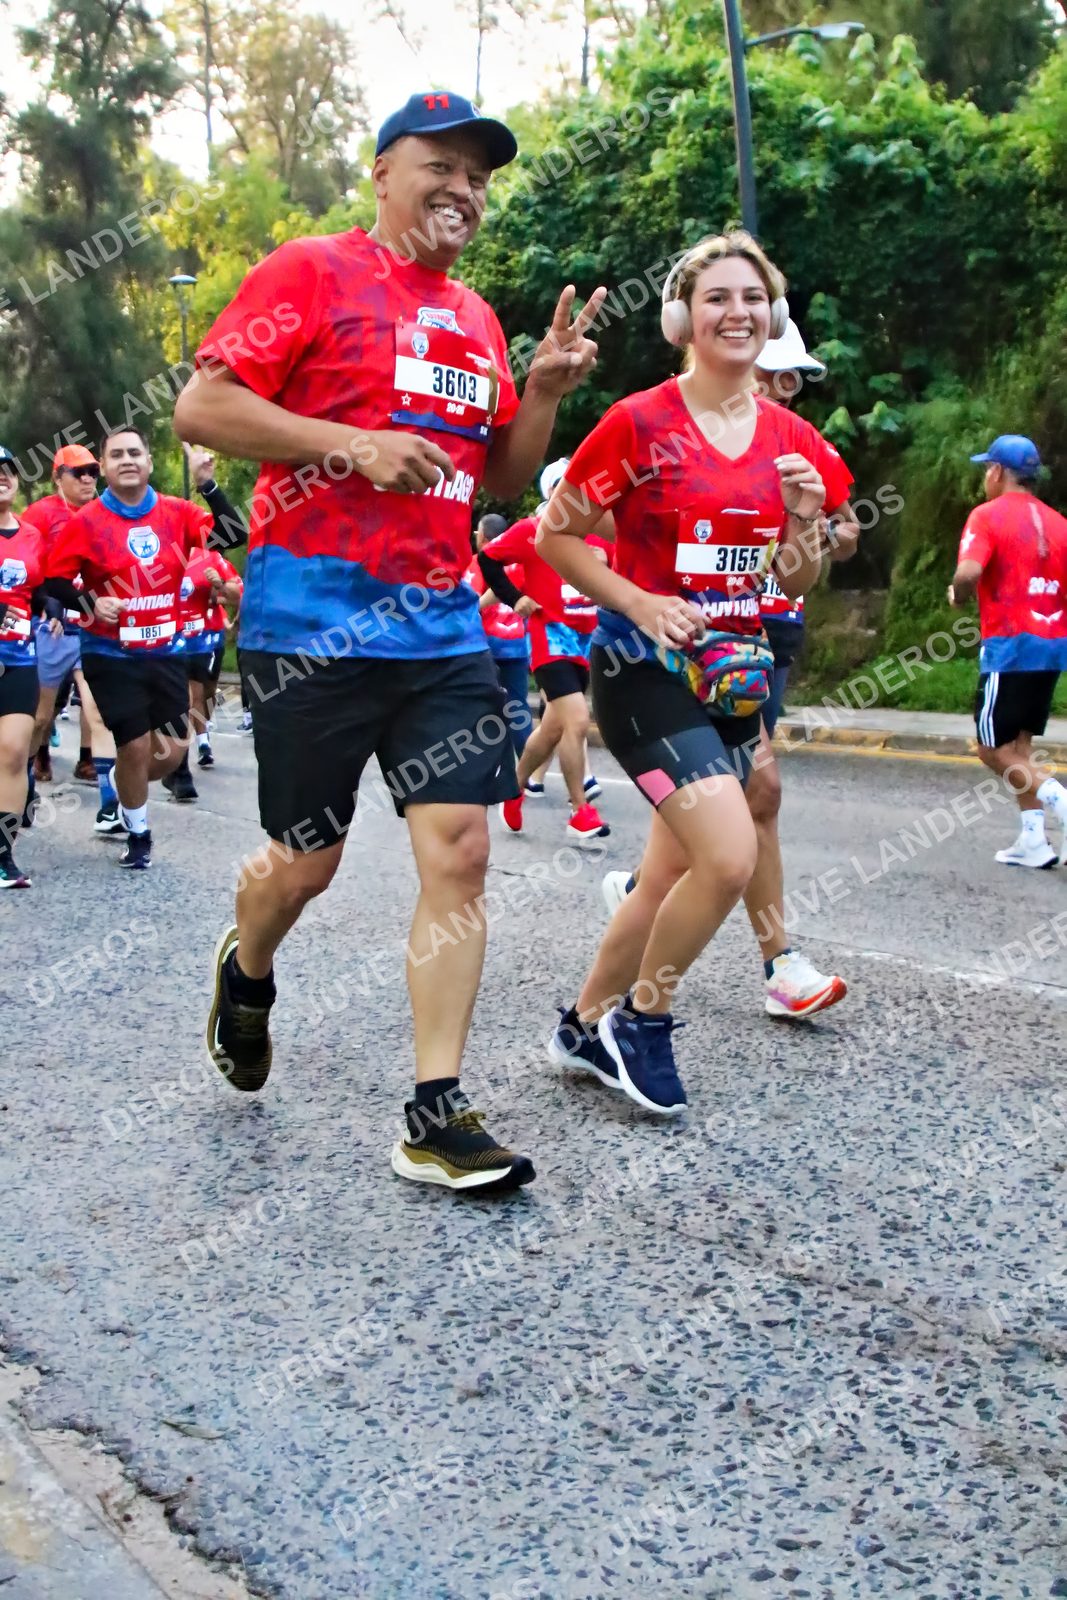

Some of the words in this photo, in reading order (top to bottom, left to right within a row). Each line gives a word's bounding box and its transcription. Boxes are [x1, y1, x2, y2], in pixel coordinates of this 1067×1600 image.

[423, 94, 449, 110] 11
[432, 366, 478, 403] 3603
[715, 547, 761, 572] 3155
[141, 627, 160, 639] 1851
